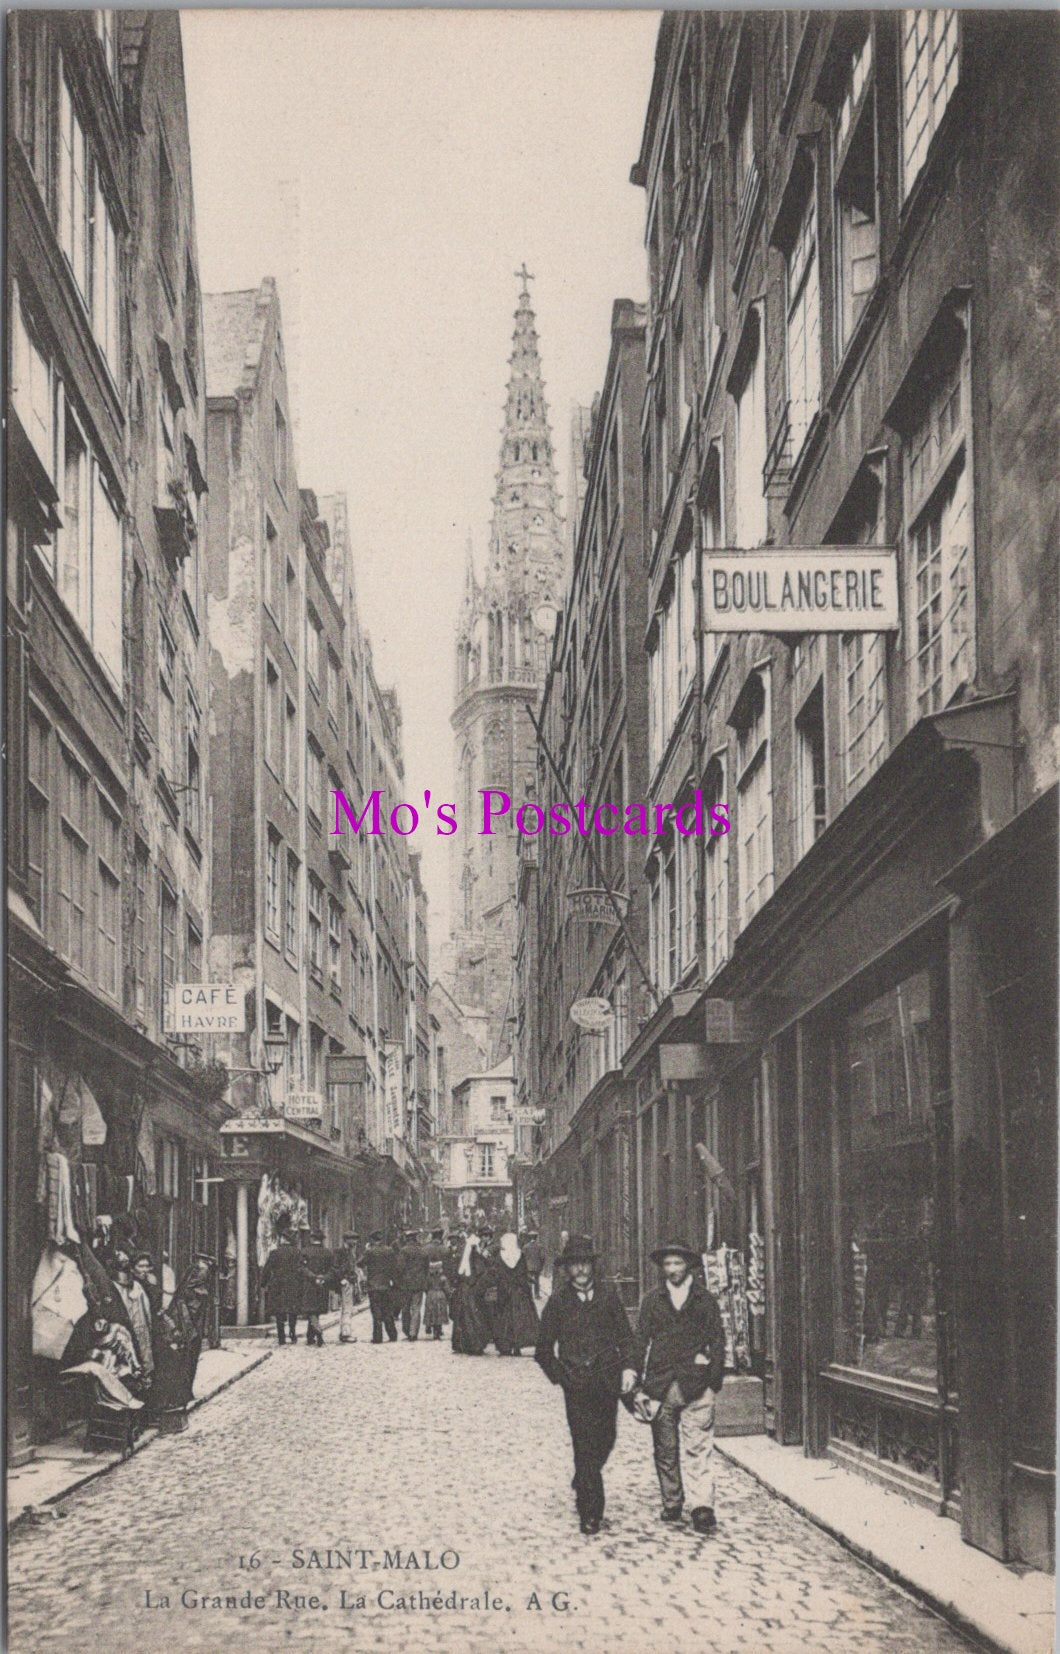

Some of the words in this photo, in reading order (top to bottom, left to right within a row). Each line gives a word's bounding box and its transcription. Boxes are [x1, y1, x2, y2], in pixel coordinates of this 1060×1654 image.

[712, 568, 885, 610] BOULANGERIE
[181, 984, 238, 1005] CAFÉ
[181, 1015, 238, 1028] HAVRE
